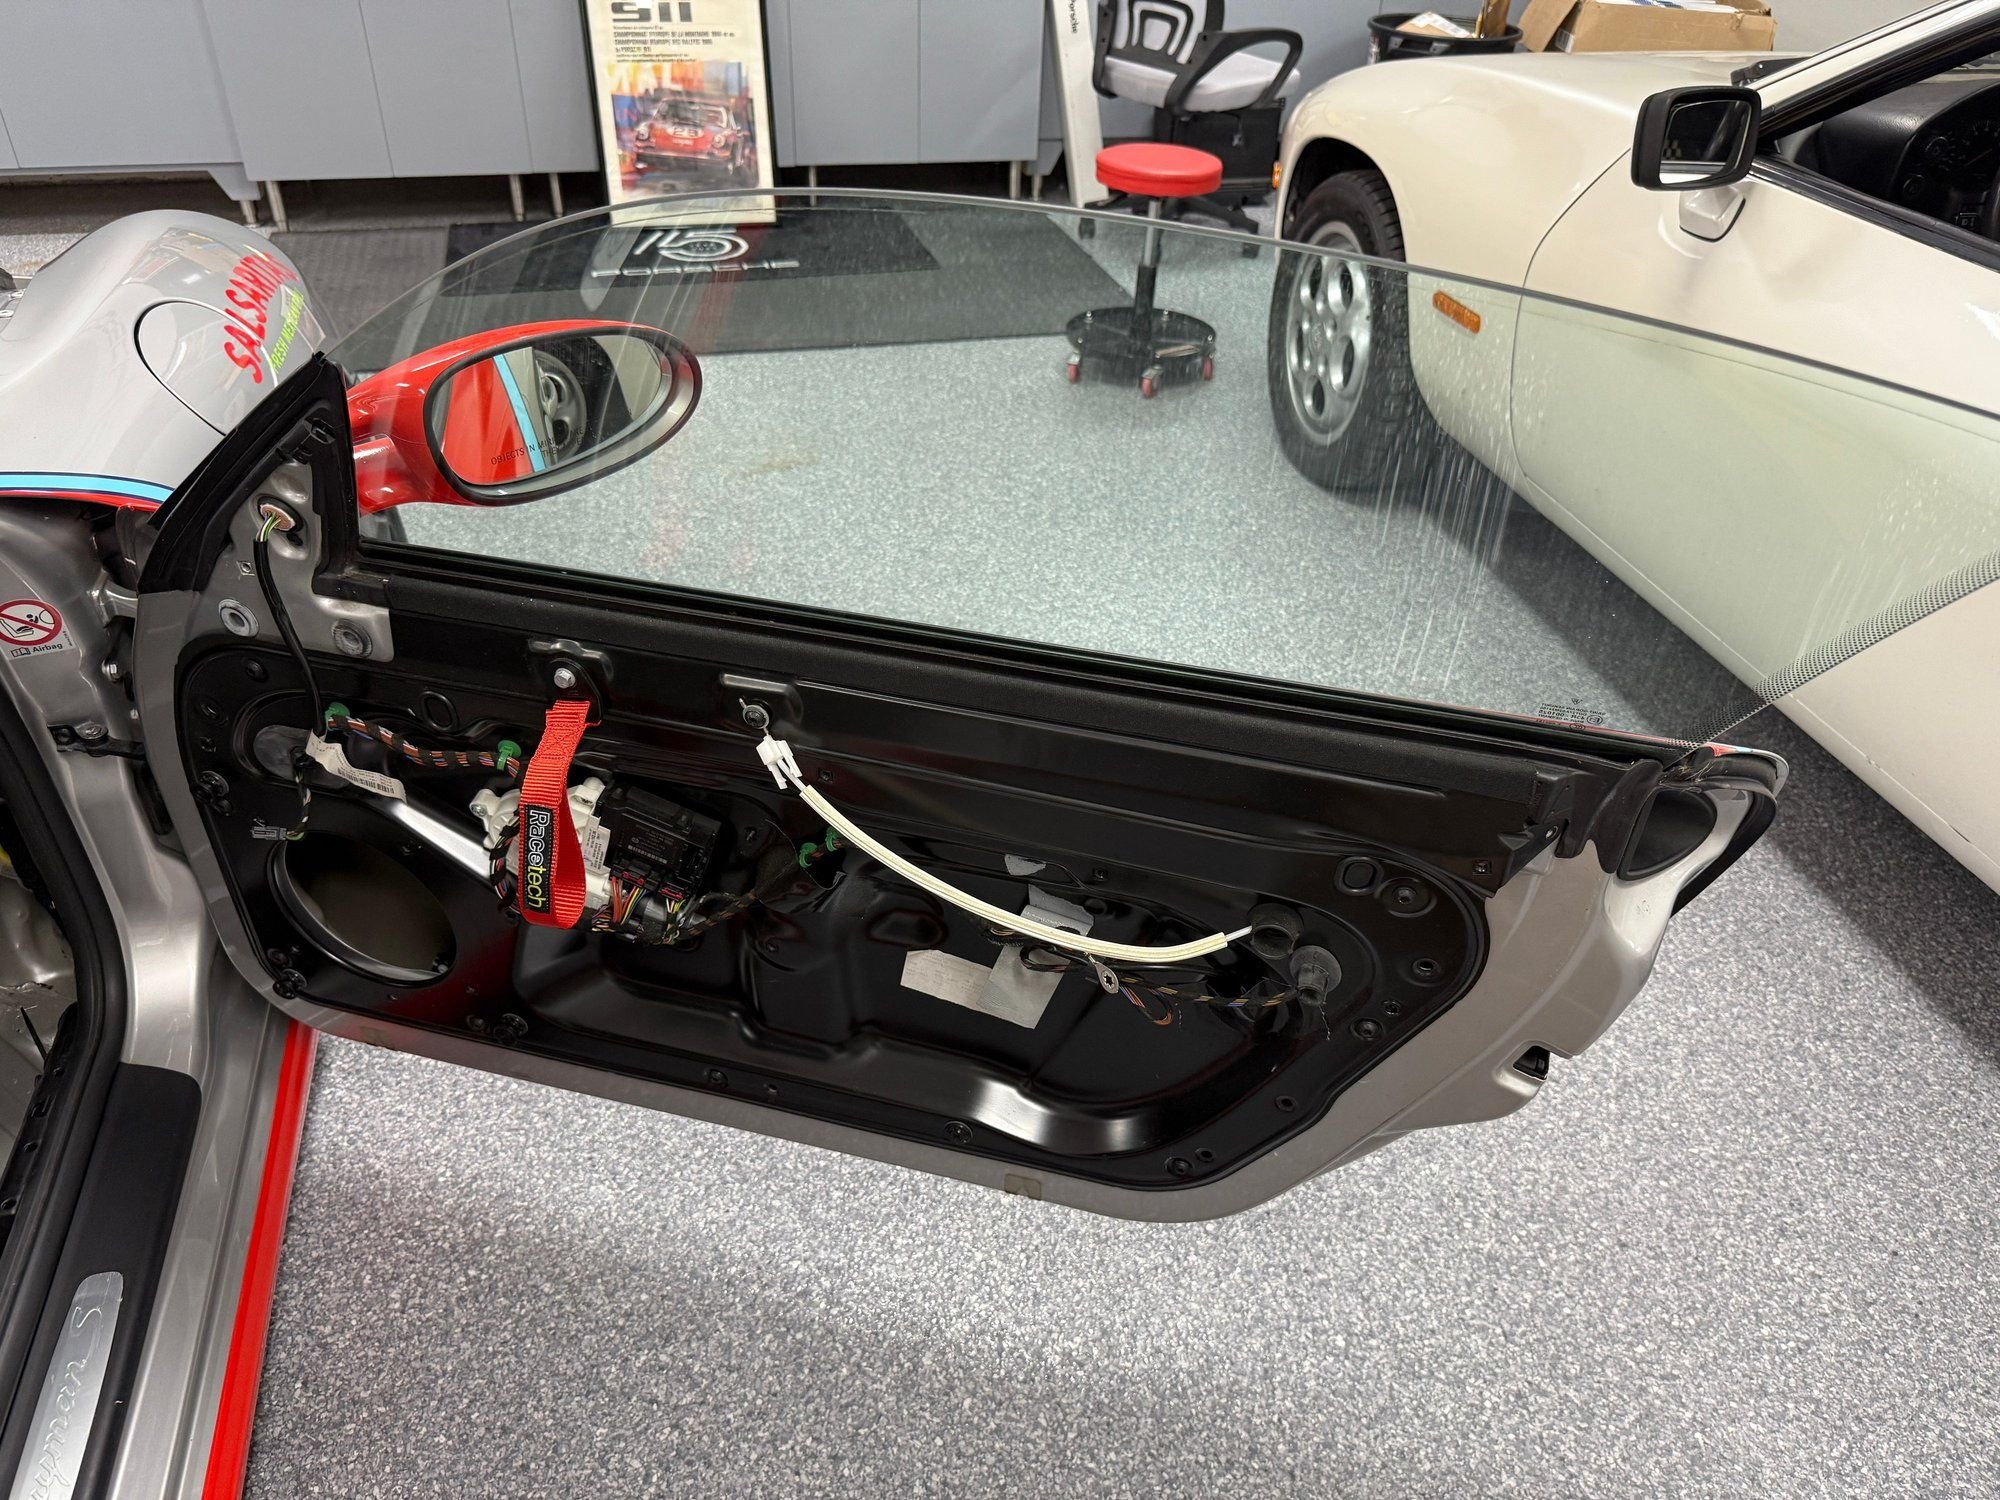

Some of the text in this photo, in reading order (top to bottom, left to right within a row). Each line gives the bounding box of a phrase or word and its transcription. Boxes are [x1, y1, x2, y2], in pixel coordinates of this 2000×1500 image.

[491, 447, 525, 465] OBJECTS
[32, 643, 63, 653] Airbag
[528, 809, 550, 908] Racetech
